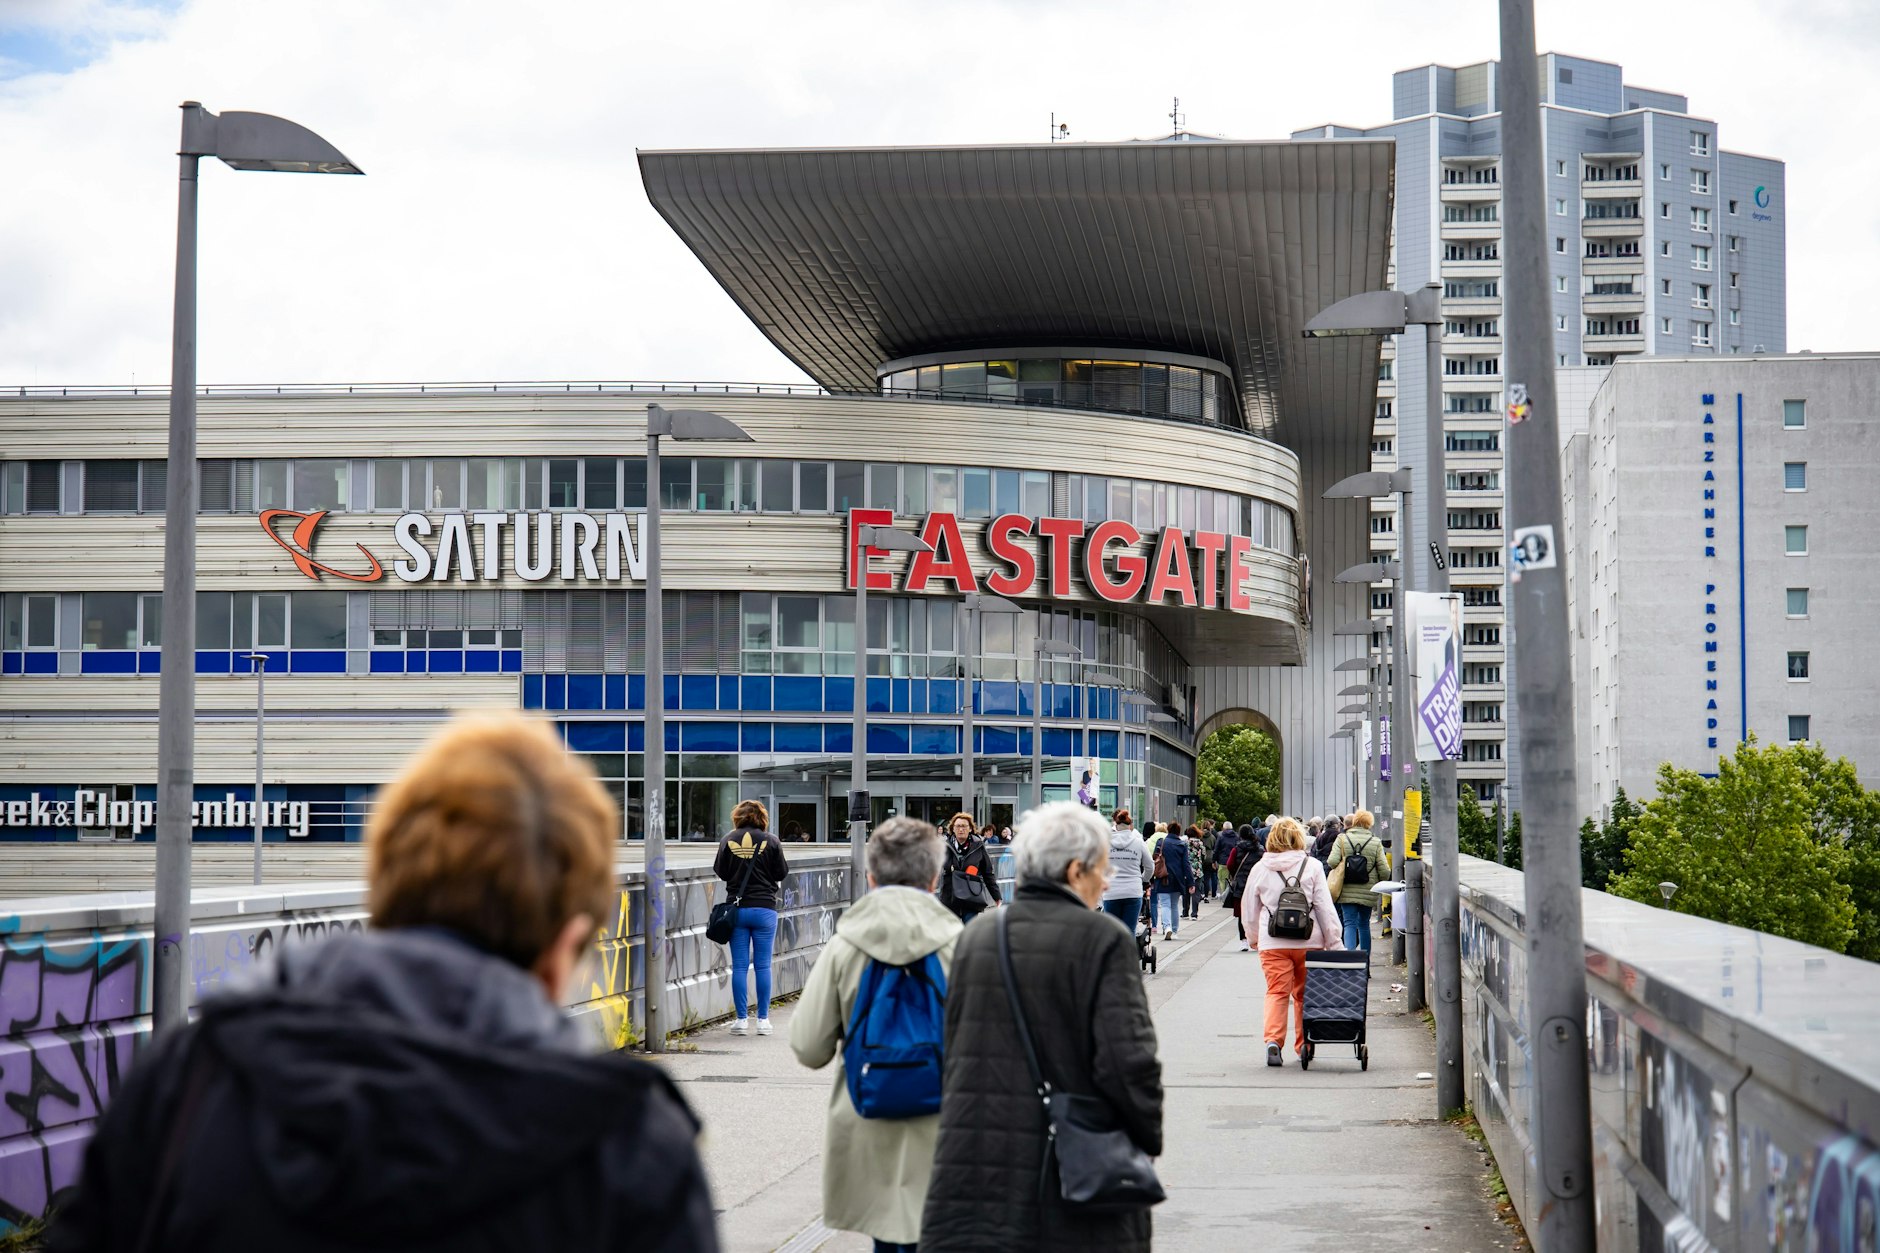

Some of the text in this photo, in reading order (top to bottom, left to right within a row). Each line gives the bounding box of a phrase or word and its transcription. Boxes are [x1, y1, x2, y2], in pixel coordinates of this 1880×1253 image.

[393, 512, 648, 582] SATURN
[846, 507, 1252, 611] EASTGATE
[1702, 394, 1717, 748] MARZAHNER PROMENADE
[1424, 670, 1457, 726] TRAU
